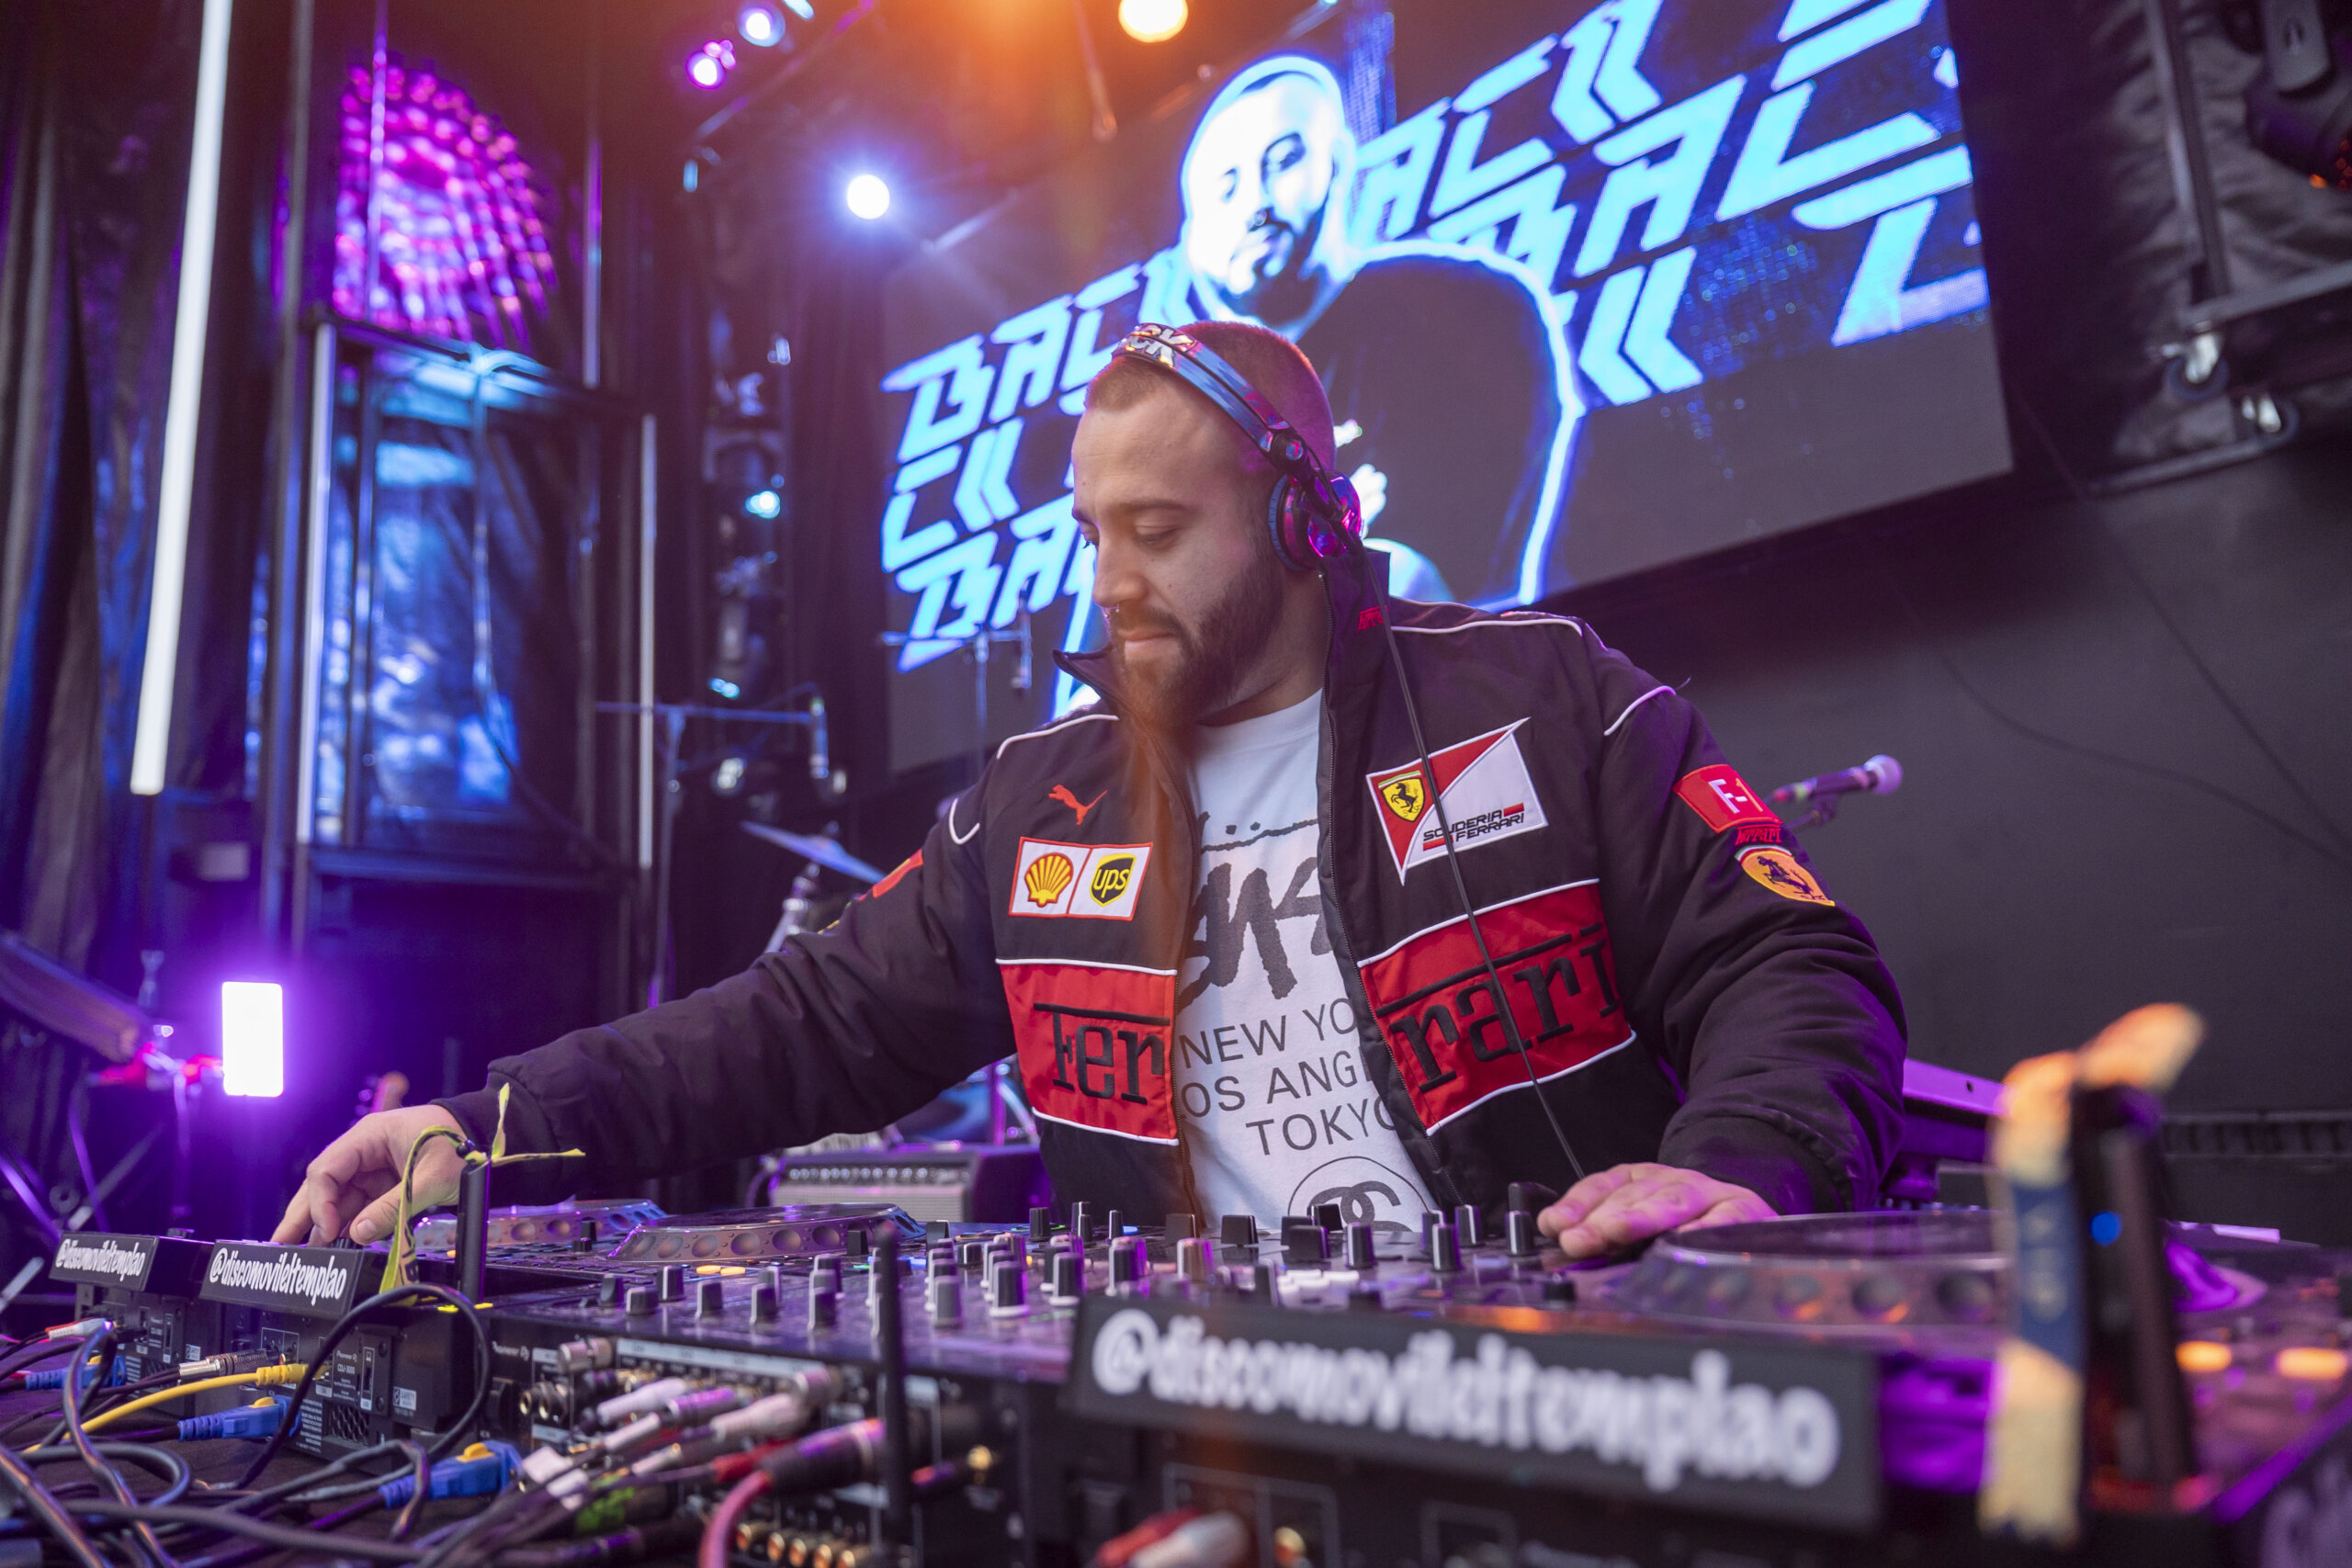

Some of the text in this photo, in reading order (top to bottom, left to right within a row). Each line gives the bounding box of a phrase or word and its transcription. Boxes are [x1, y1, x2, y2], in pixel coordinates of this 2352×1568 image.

[1455, 812, 1525, 842] FERRARI
[1093, 868, 1132, 898] ups
[1376, 921, 1620, 1094] rari
[1034, 1002, 1171, 1106] Fer
[1179, 1014, 1287, 1069] NEW
